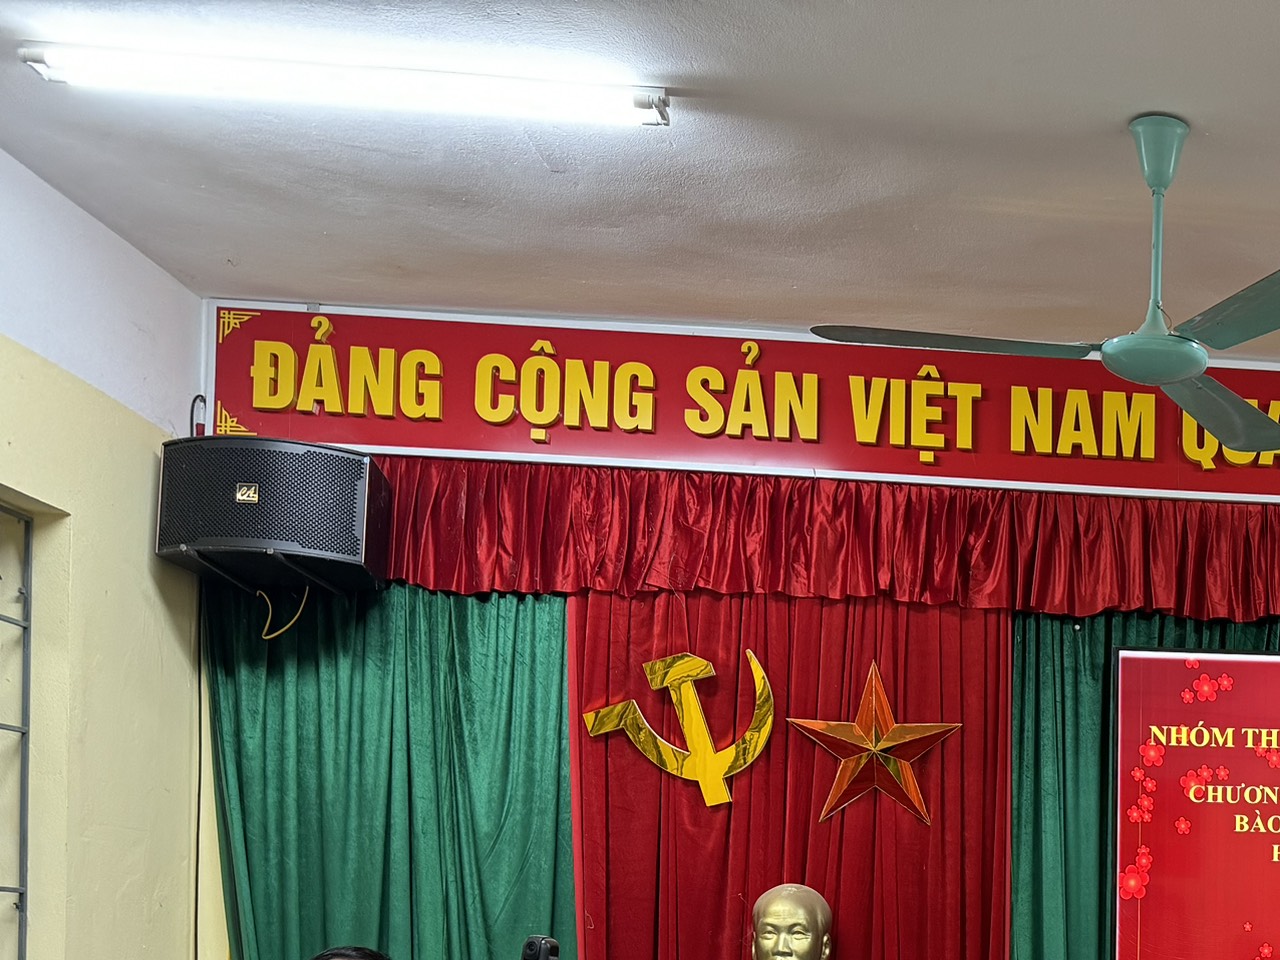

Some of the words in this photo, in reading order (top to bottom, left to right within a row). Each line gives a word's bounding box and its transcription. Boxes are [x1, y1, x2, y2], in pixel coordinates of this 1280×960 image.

[250, 316, 444, 421] ĐẢNG
[474, 339, 657, 443] CỘNG
[684, 340, 820, 442] SẢN
[849, 365, 983, 466] VIỆT
[1010, 386, 1156, 462] NAM
[1149, 721, 1236, 748] NHÓM
